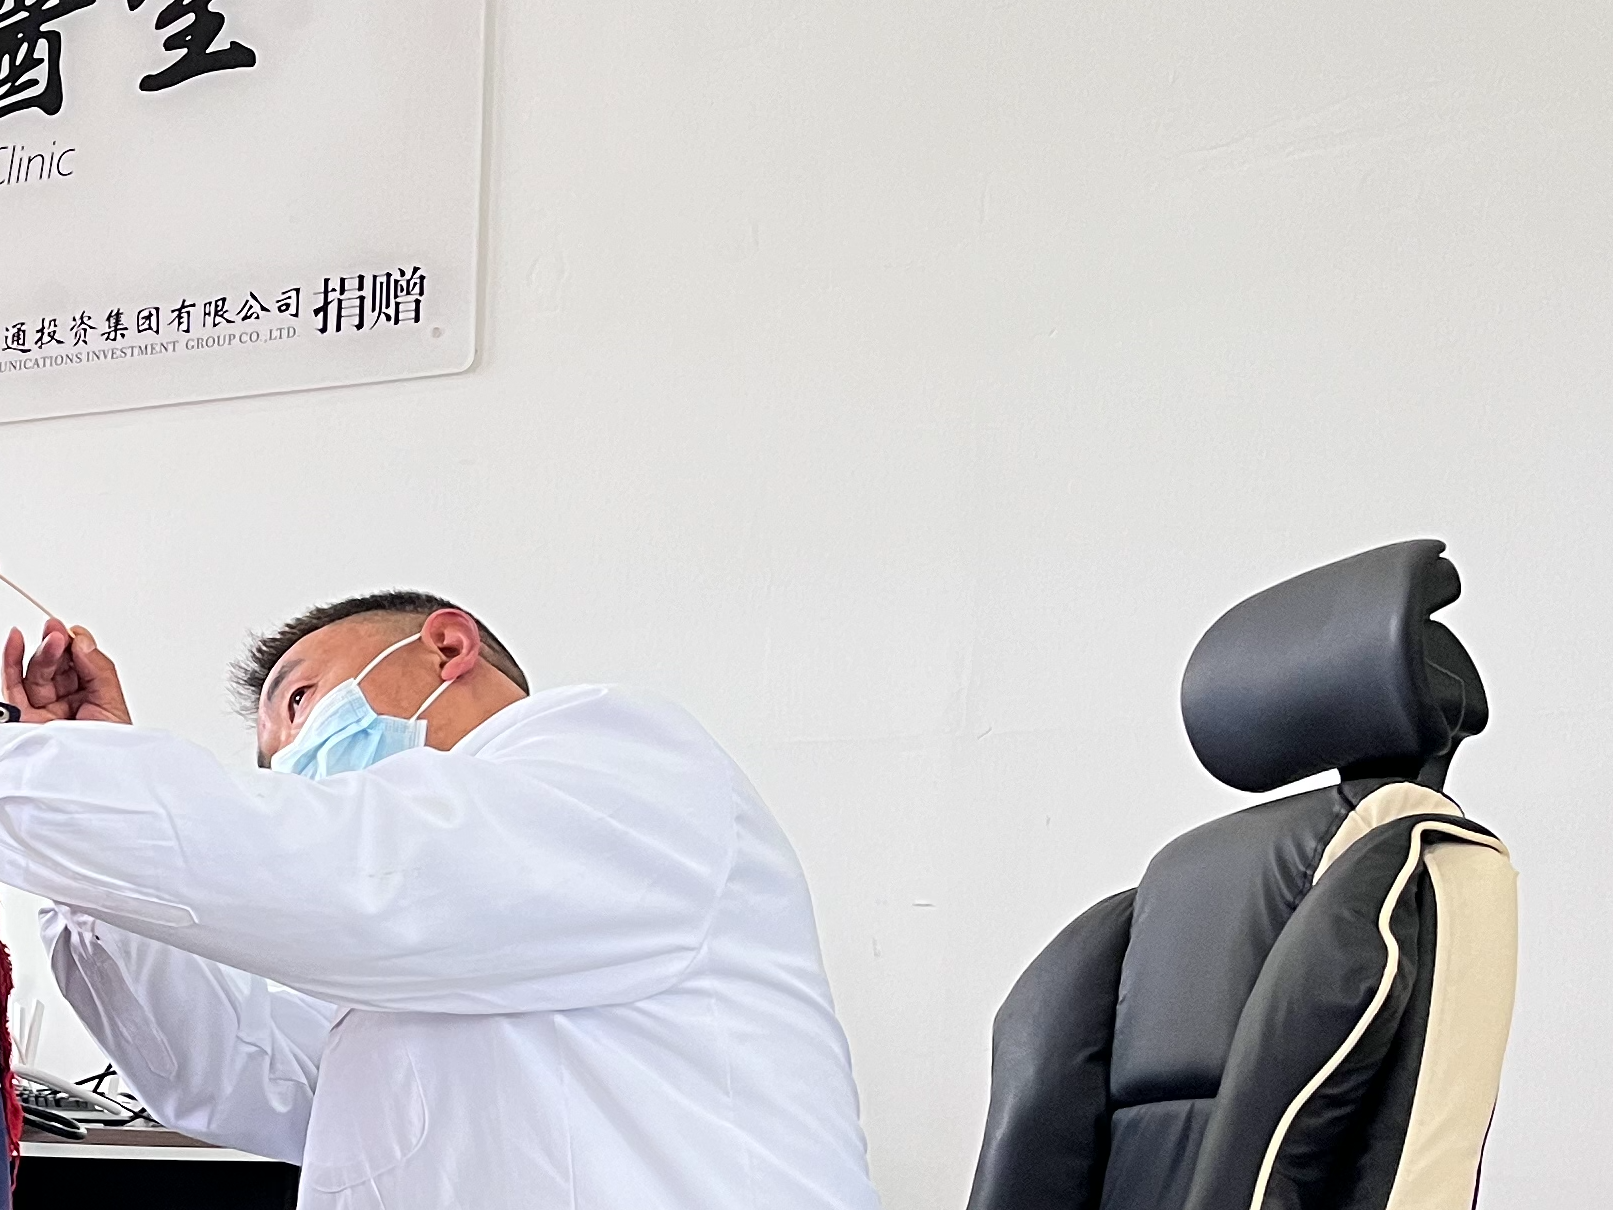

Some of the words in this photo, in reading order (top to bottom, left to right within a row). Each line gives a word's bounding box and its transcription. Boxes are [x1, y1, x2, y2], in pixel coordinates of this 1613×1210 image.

[312, 265, 426, 335] 捐赠
[86, 339, 180, 364] INVESTMENT
[185, 333, 237, 351] GROUP
